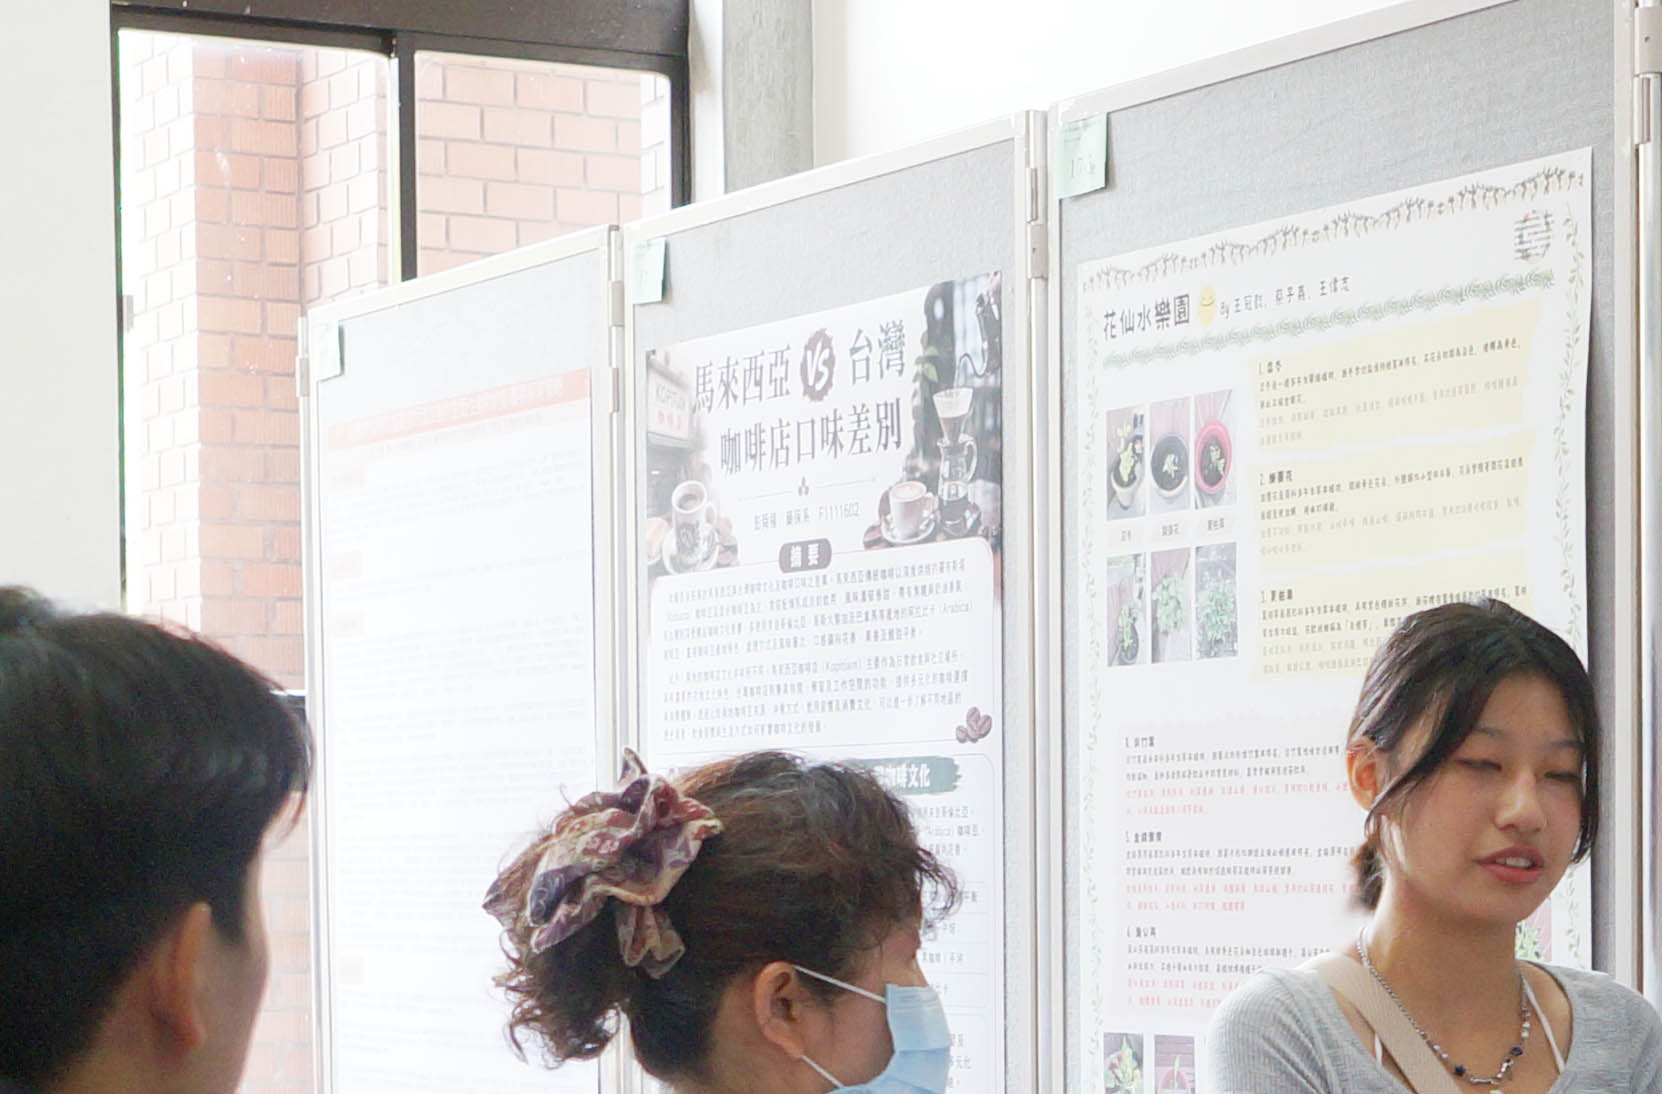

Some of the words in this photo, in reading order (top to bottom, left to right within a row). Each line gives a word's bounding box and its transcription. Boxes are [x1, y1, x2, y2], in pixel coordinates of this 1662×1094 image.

[1103, 293, 1190, 341] 花仙水樂園
[695, 344, 791, 415] 馬來西亞
[806, 340, 830, 391] VS
[850, 319, 906, 386] 台灣
[720, 397, 902, 476] 咖啡店口味差別
